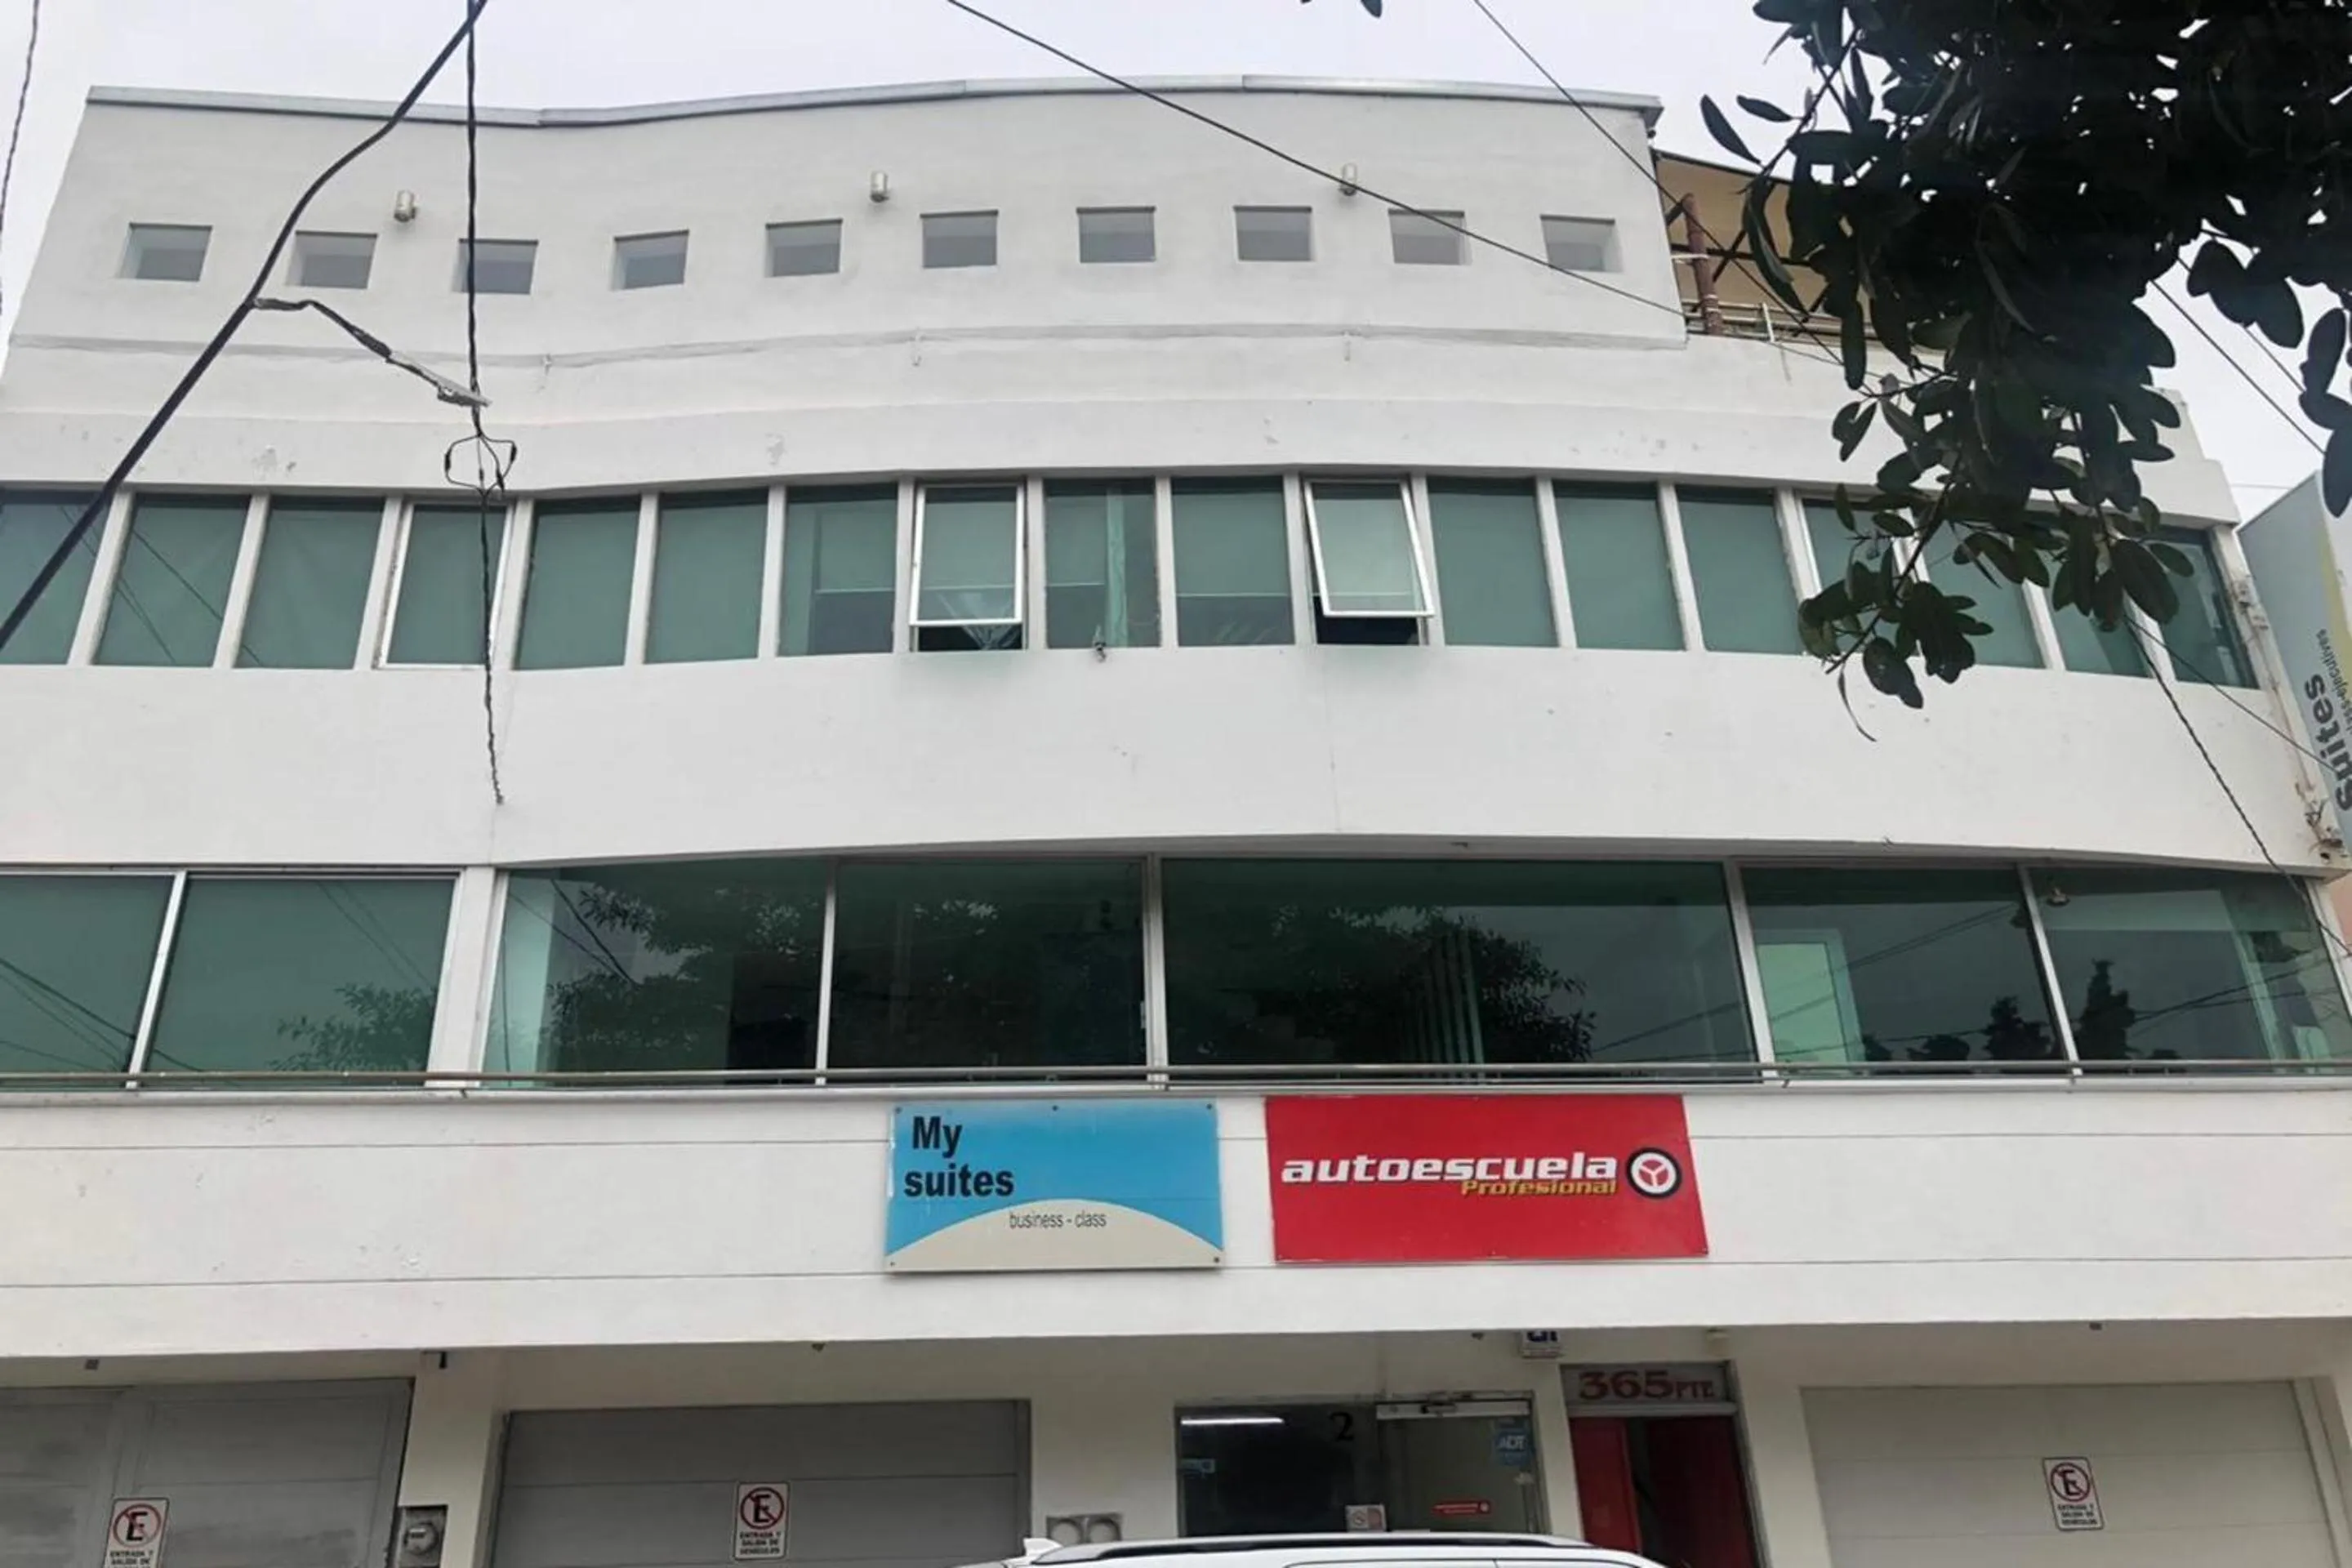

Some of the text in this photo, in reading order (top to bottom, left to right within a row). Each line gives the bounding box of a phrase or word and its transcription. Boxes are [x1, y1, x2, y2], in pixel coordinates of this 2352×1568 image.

[2305, 674, 2352, 812] suites
[911, 1116, 963, 1158] My
[904, 1163, 1014, 1197] suites
[1281, 1152, 1617, 1183] autoescuela
[1460, 1178, 1616, 1196] Profesional
[1009, 1210, 1064, 1229] business
[1075, 1209, 1107, 1228] class
[1330, 1411, 1353, 1441] 2
[1498, 1435, 1525, 1450] ADT
